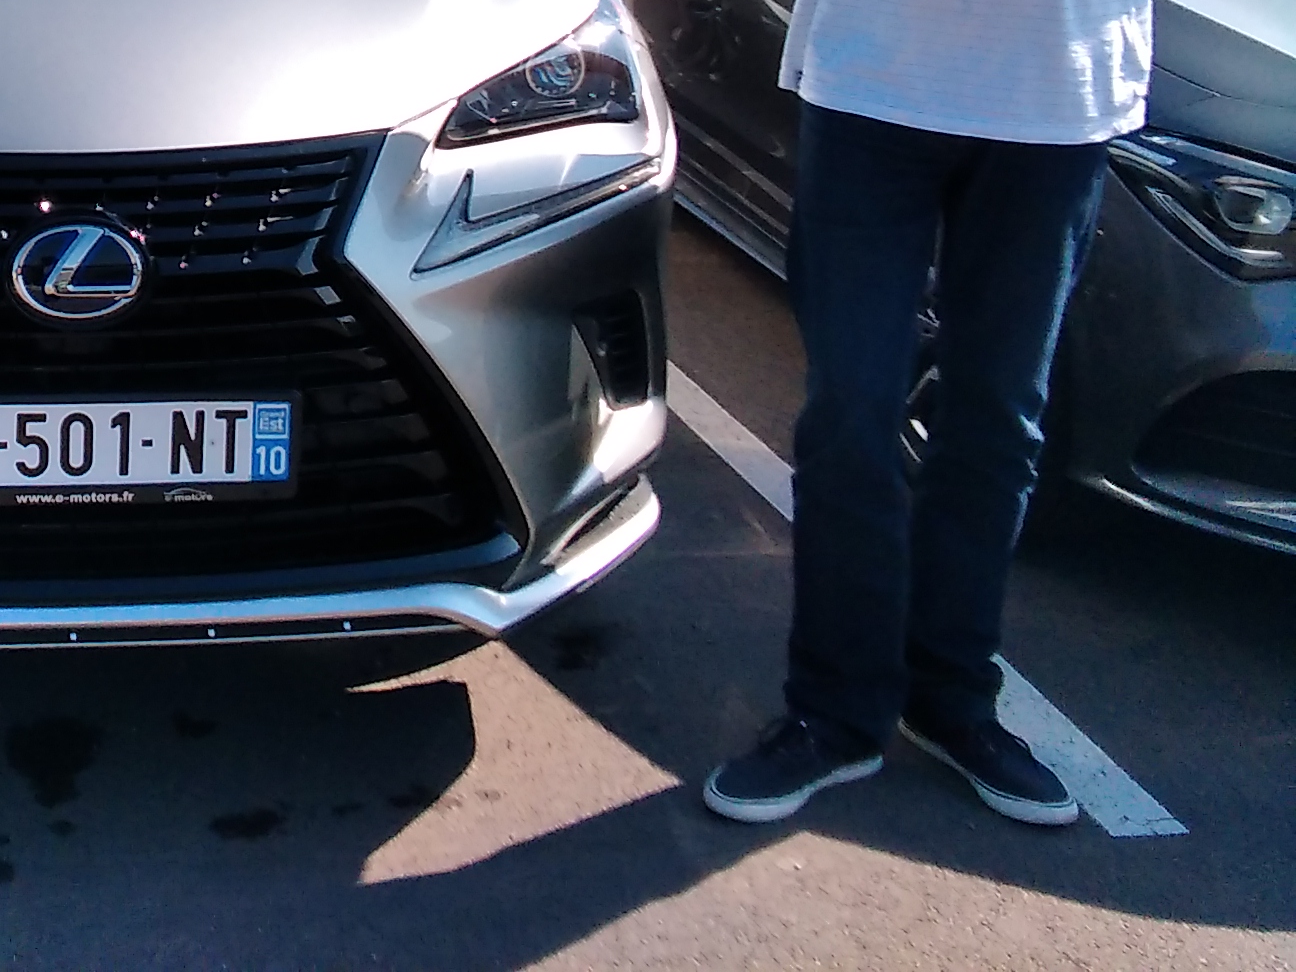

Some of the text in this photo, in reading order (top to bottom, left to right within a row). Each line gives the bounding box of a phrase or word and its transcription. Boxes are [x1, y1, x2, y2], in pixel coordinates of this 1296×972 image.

[260, 417, 284, 431] Est
[256, 445, 286, 476] 10
[15, 490, 136, 505] www.e-motors.fr
